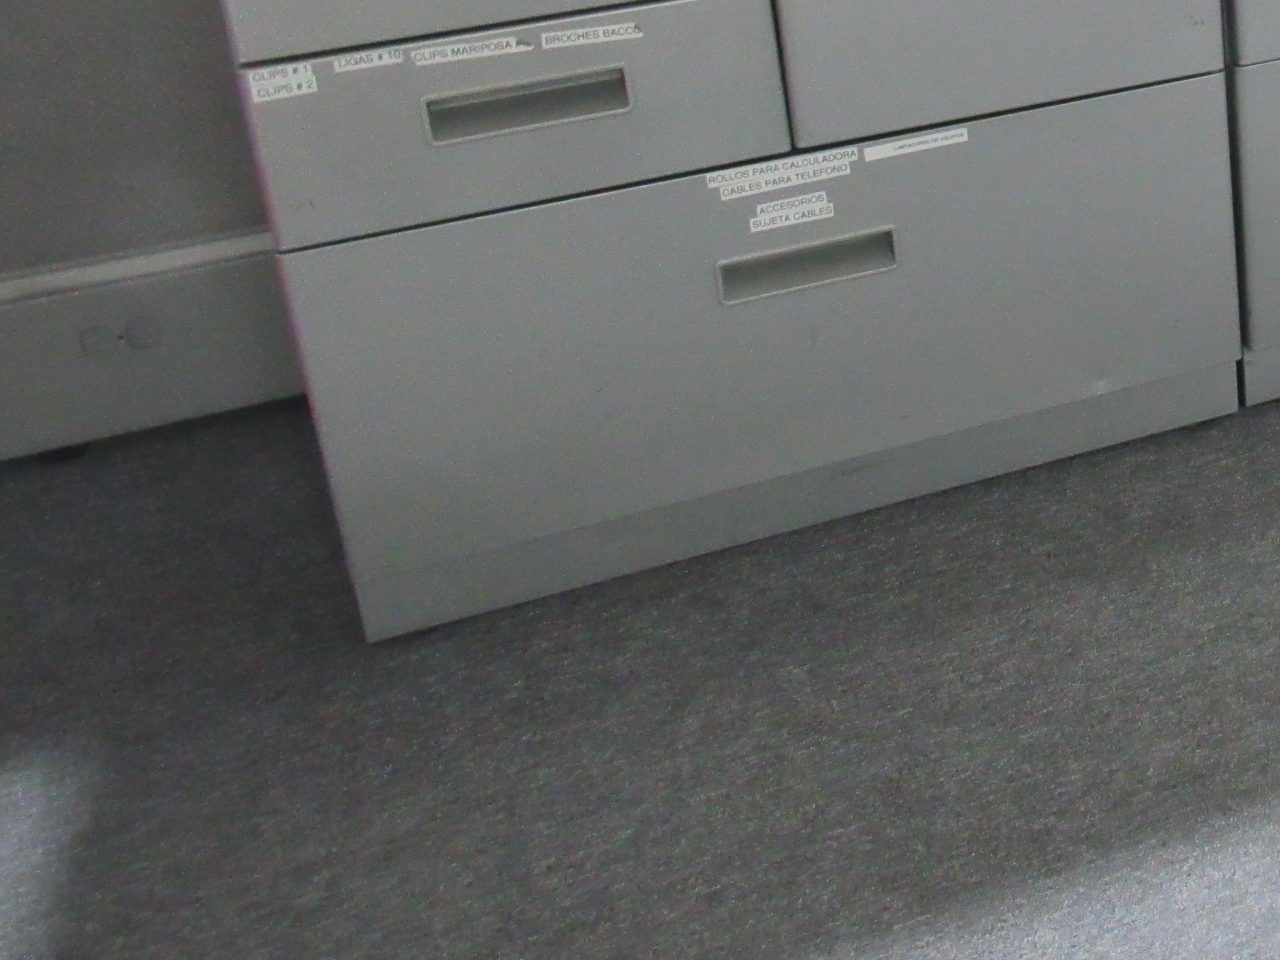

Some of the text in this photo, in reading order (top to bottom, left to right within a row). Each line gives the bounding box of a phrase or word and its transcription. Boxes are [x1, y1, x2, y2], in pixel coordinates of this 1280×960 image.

[544, 30, 600, 44] BROCHES
[338, 53, 374, 68] LIGAS
[414, 40, 512, 61] CLIPS MARIPOSA
[252, 67, 289, 82] CLIPS
[256, 82, 294, 98] CLIPS
[708, 150, 857, 185] ROLLOS PARA CALCULADORA
[722, 163, 848, 197] CABLES PARA TELEFONO
[758, 194, 826, 215] ACCESORIOS
[752, 206, 833, 229] SUJETA CABLES
